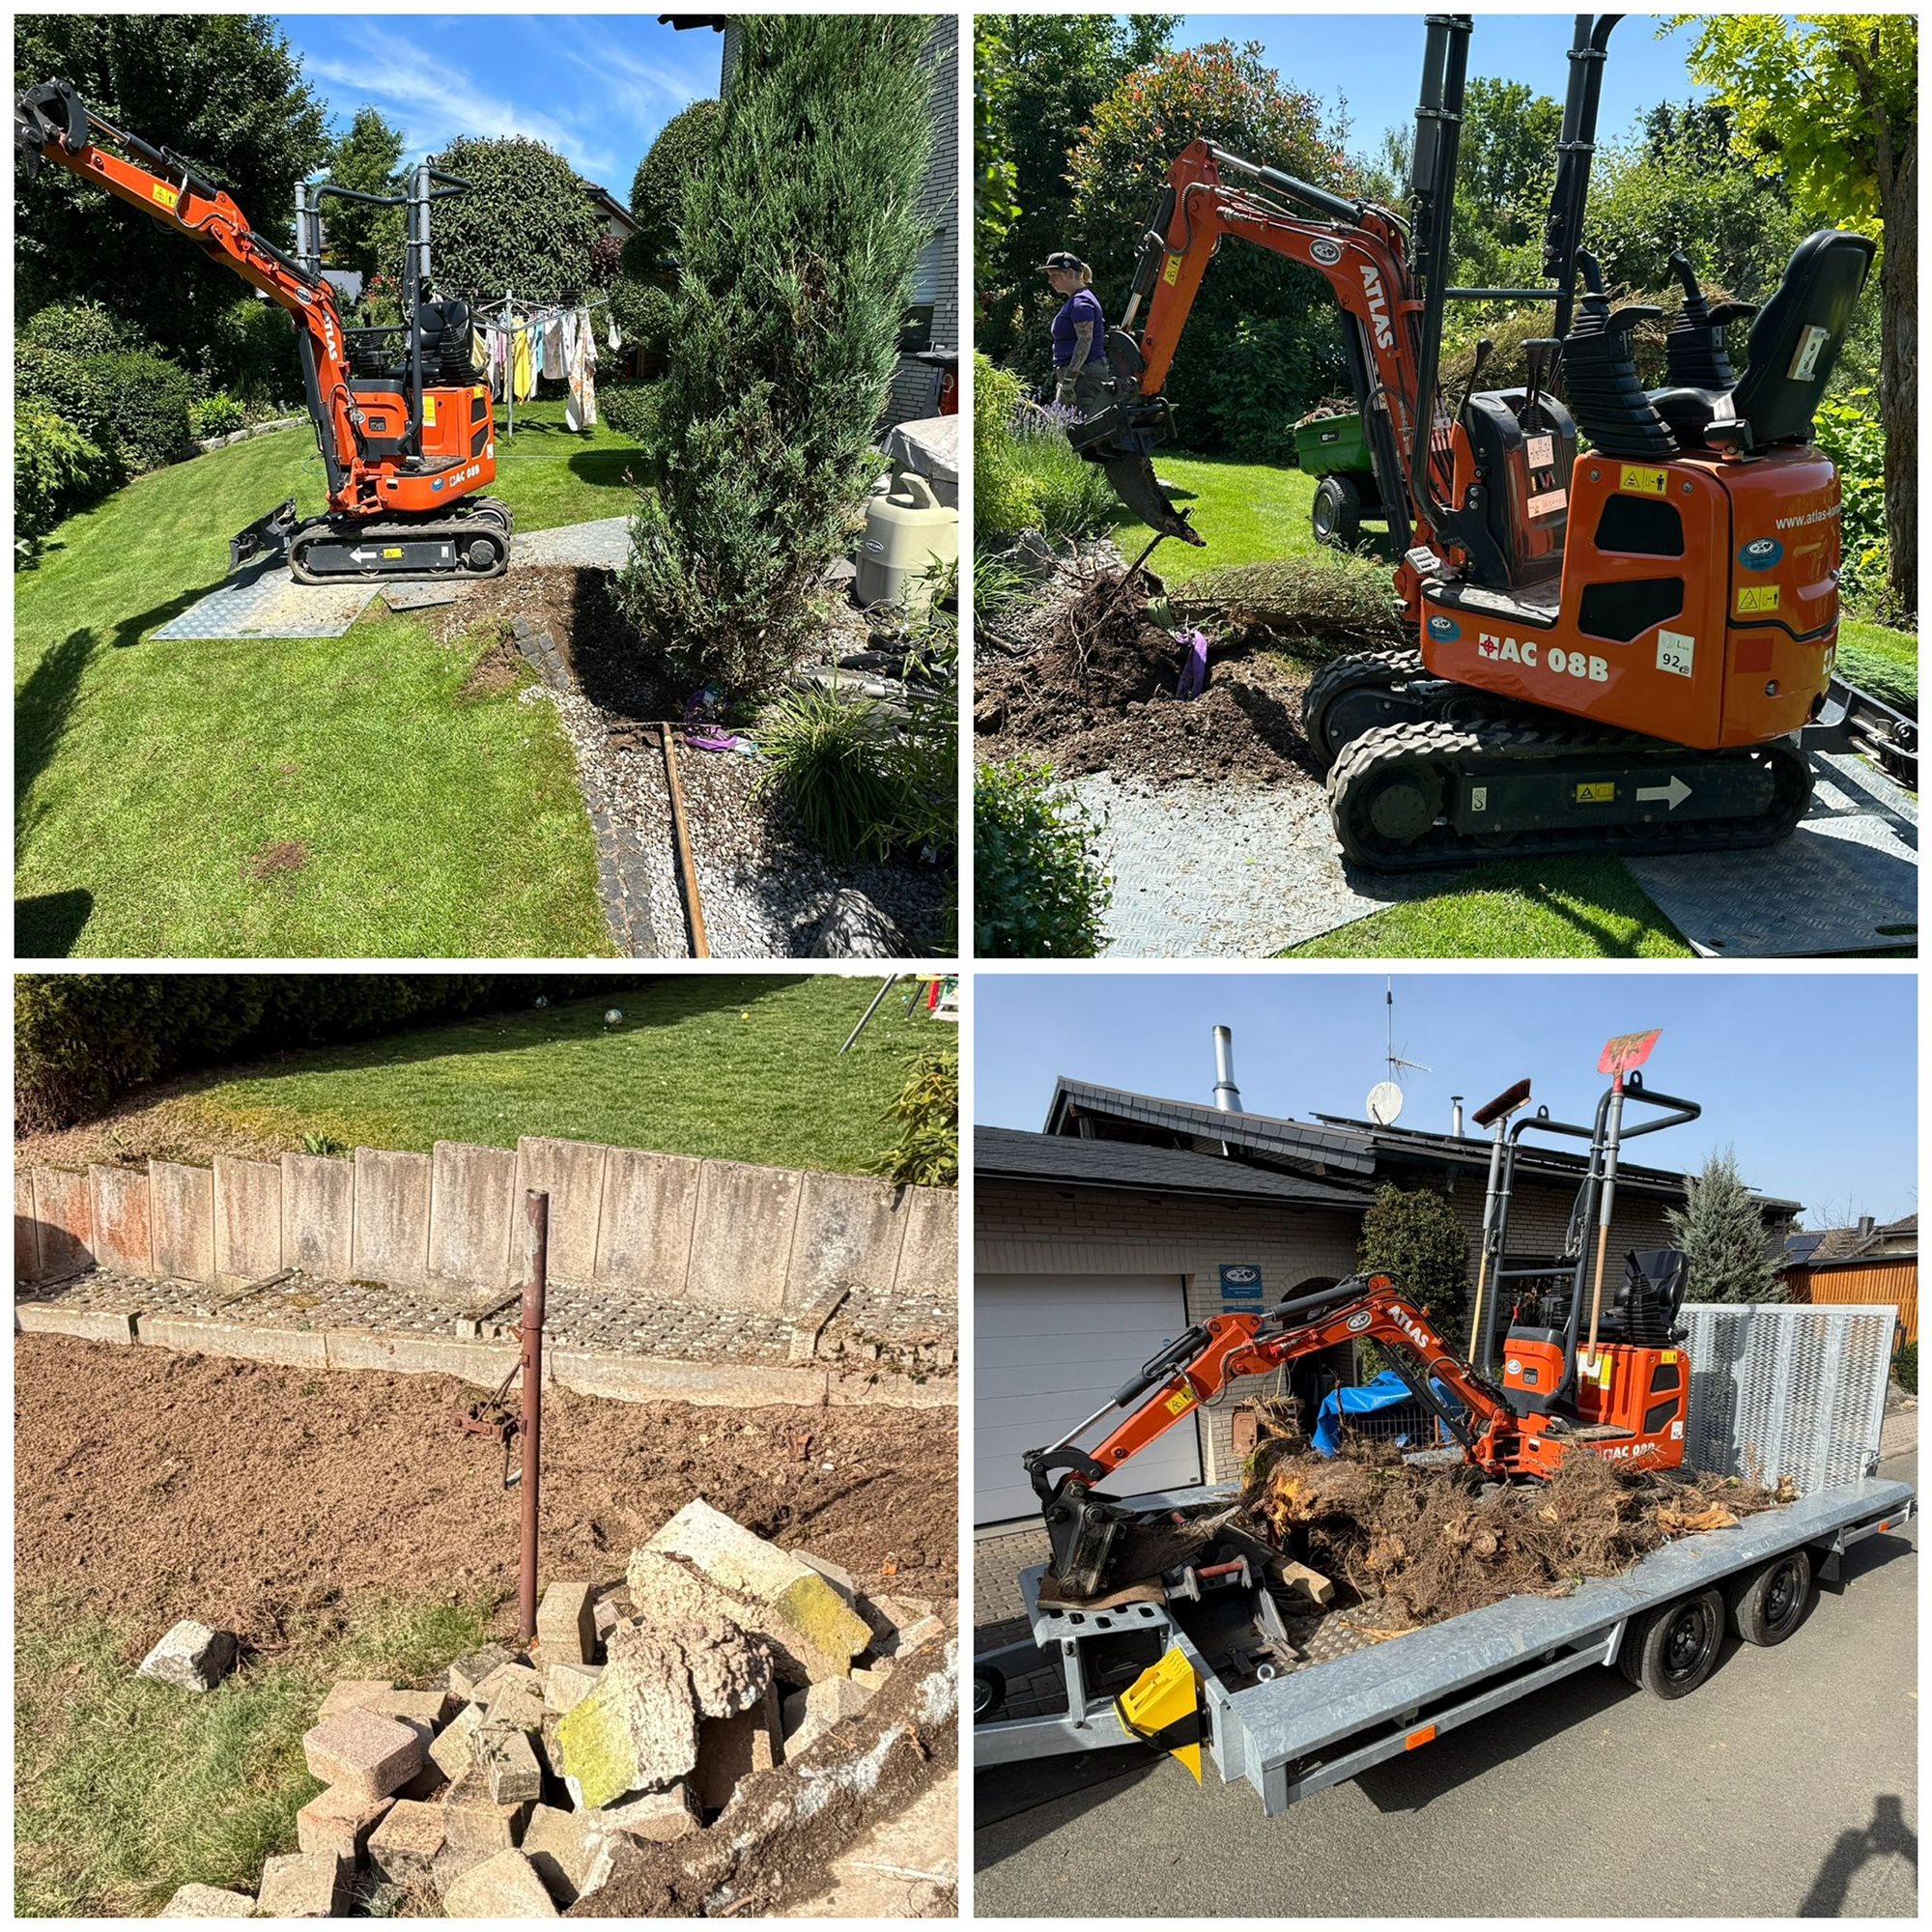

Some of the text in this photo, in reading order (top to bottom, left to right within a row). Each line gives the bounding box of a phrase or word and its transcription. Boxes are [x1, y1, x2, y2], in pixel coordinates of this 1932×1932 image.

[1359, 265, 1394, 350] ATLAS
[322, 309, 338, 360] ATLAS
[1498, 637, 1609, 682] AC 08B
[1662, 652, 1680, 668] 92
[1386, 1304, 1430, 1349] ATLAS
